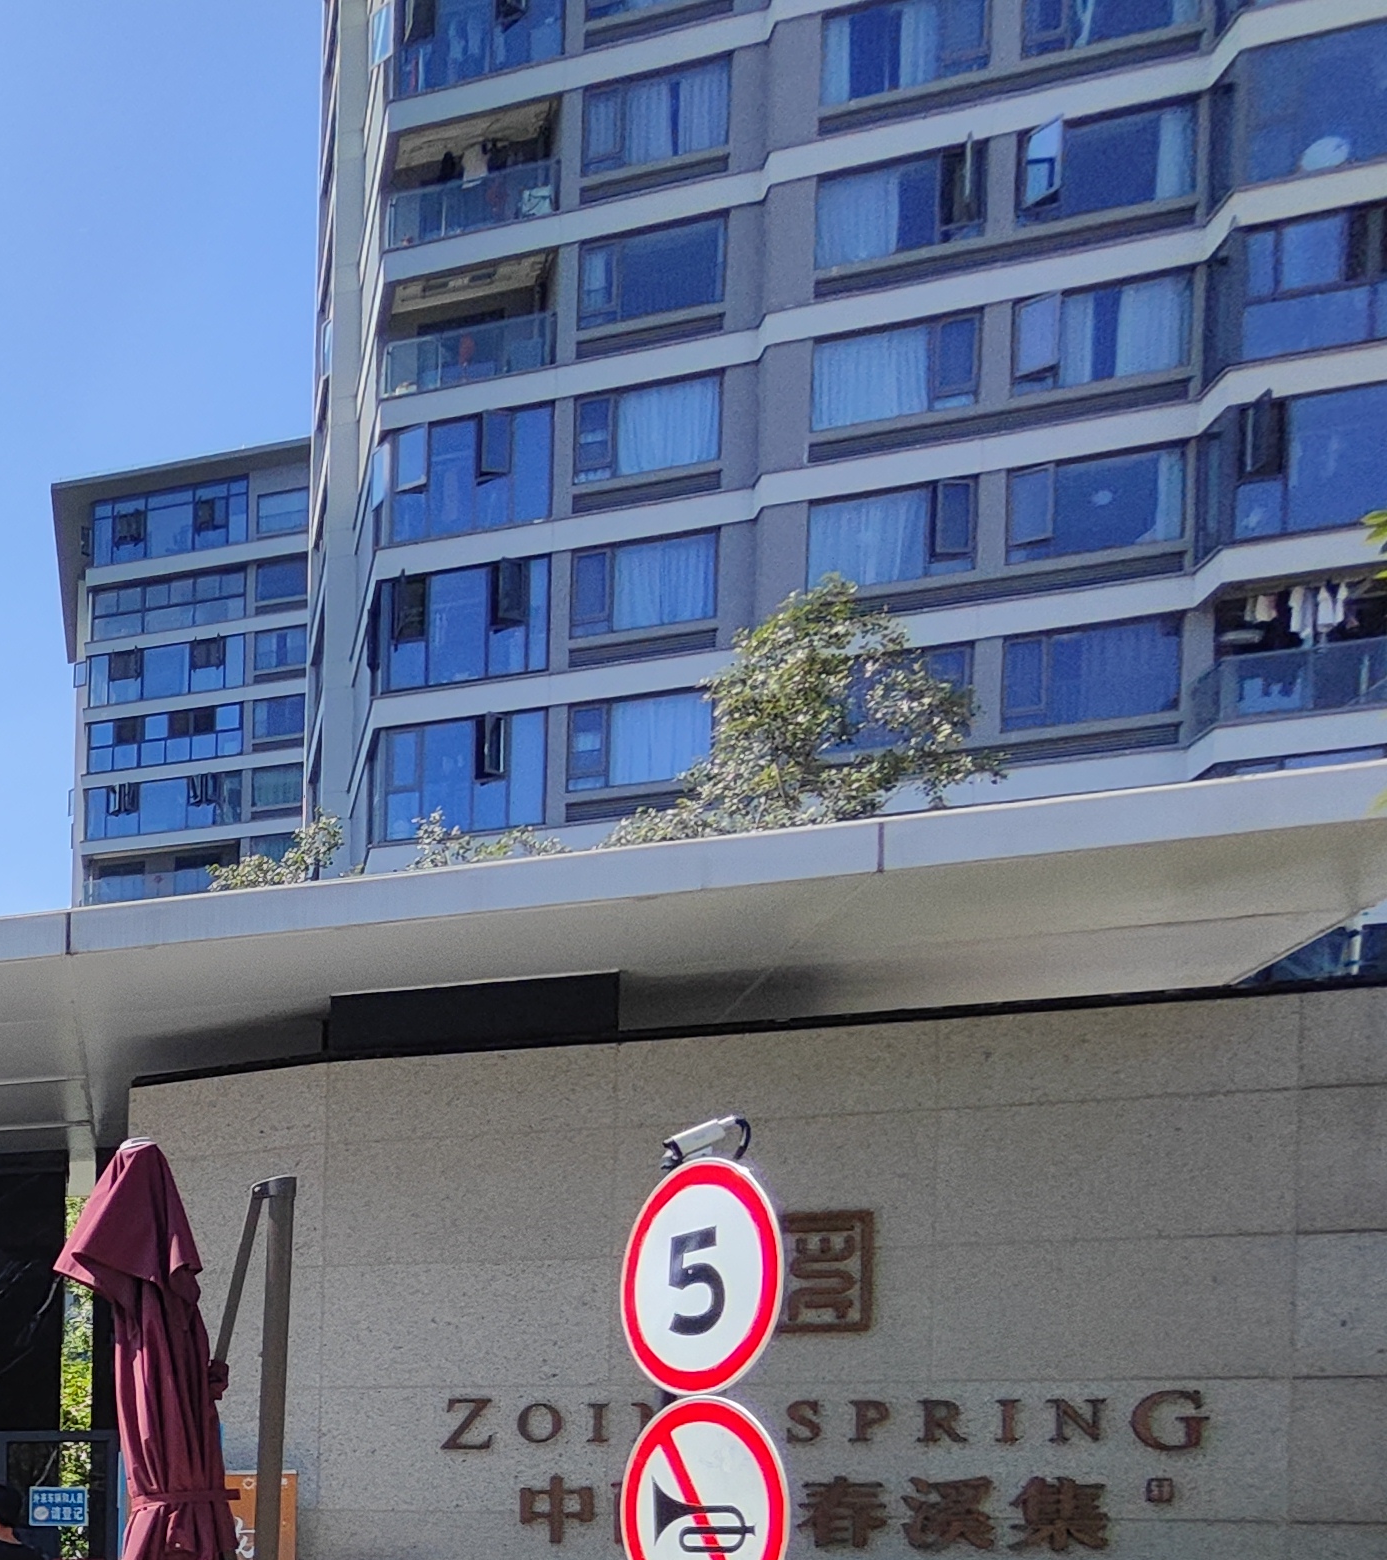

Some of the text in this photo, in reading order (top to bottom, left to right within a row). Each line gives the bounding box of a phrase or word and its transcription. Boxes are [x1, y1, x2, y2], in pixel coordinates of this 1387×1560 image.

[668, 1225, 726, 1336] 5
[440, 1390, 1210, 1450] ZOI SPRING
[51, 1506, 84, 1521] 请登记
[797, 1476, 1108, 1549] 春溪集
